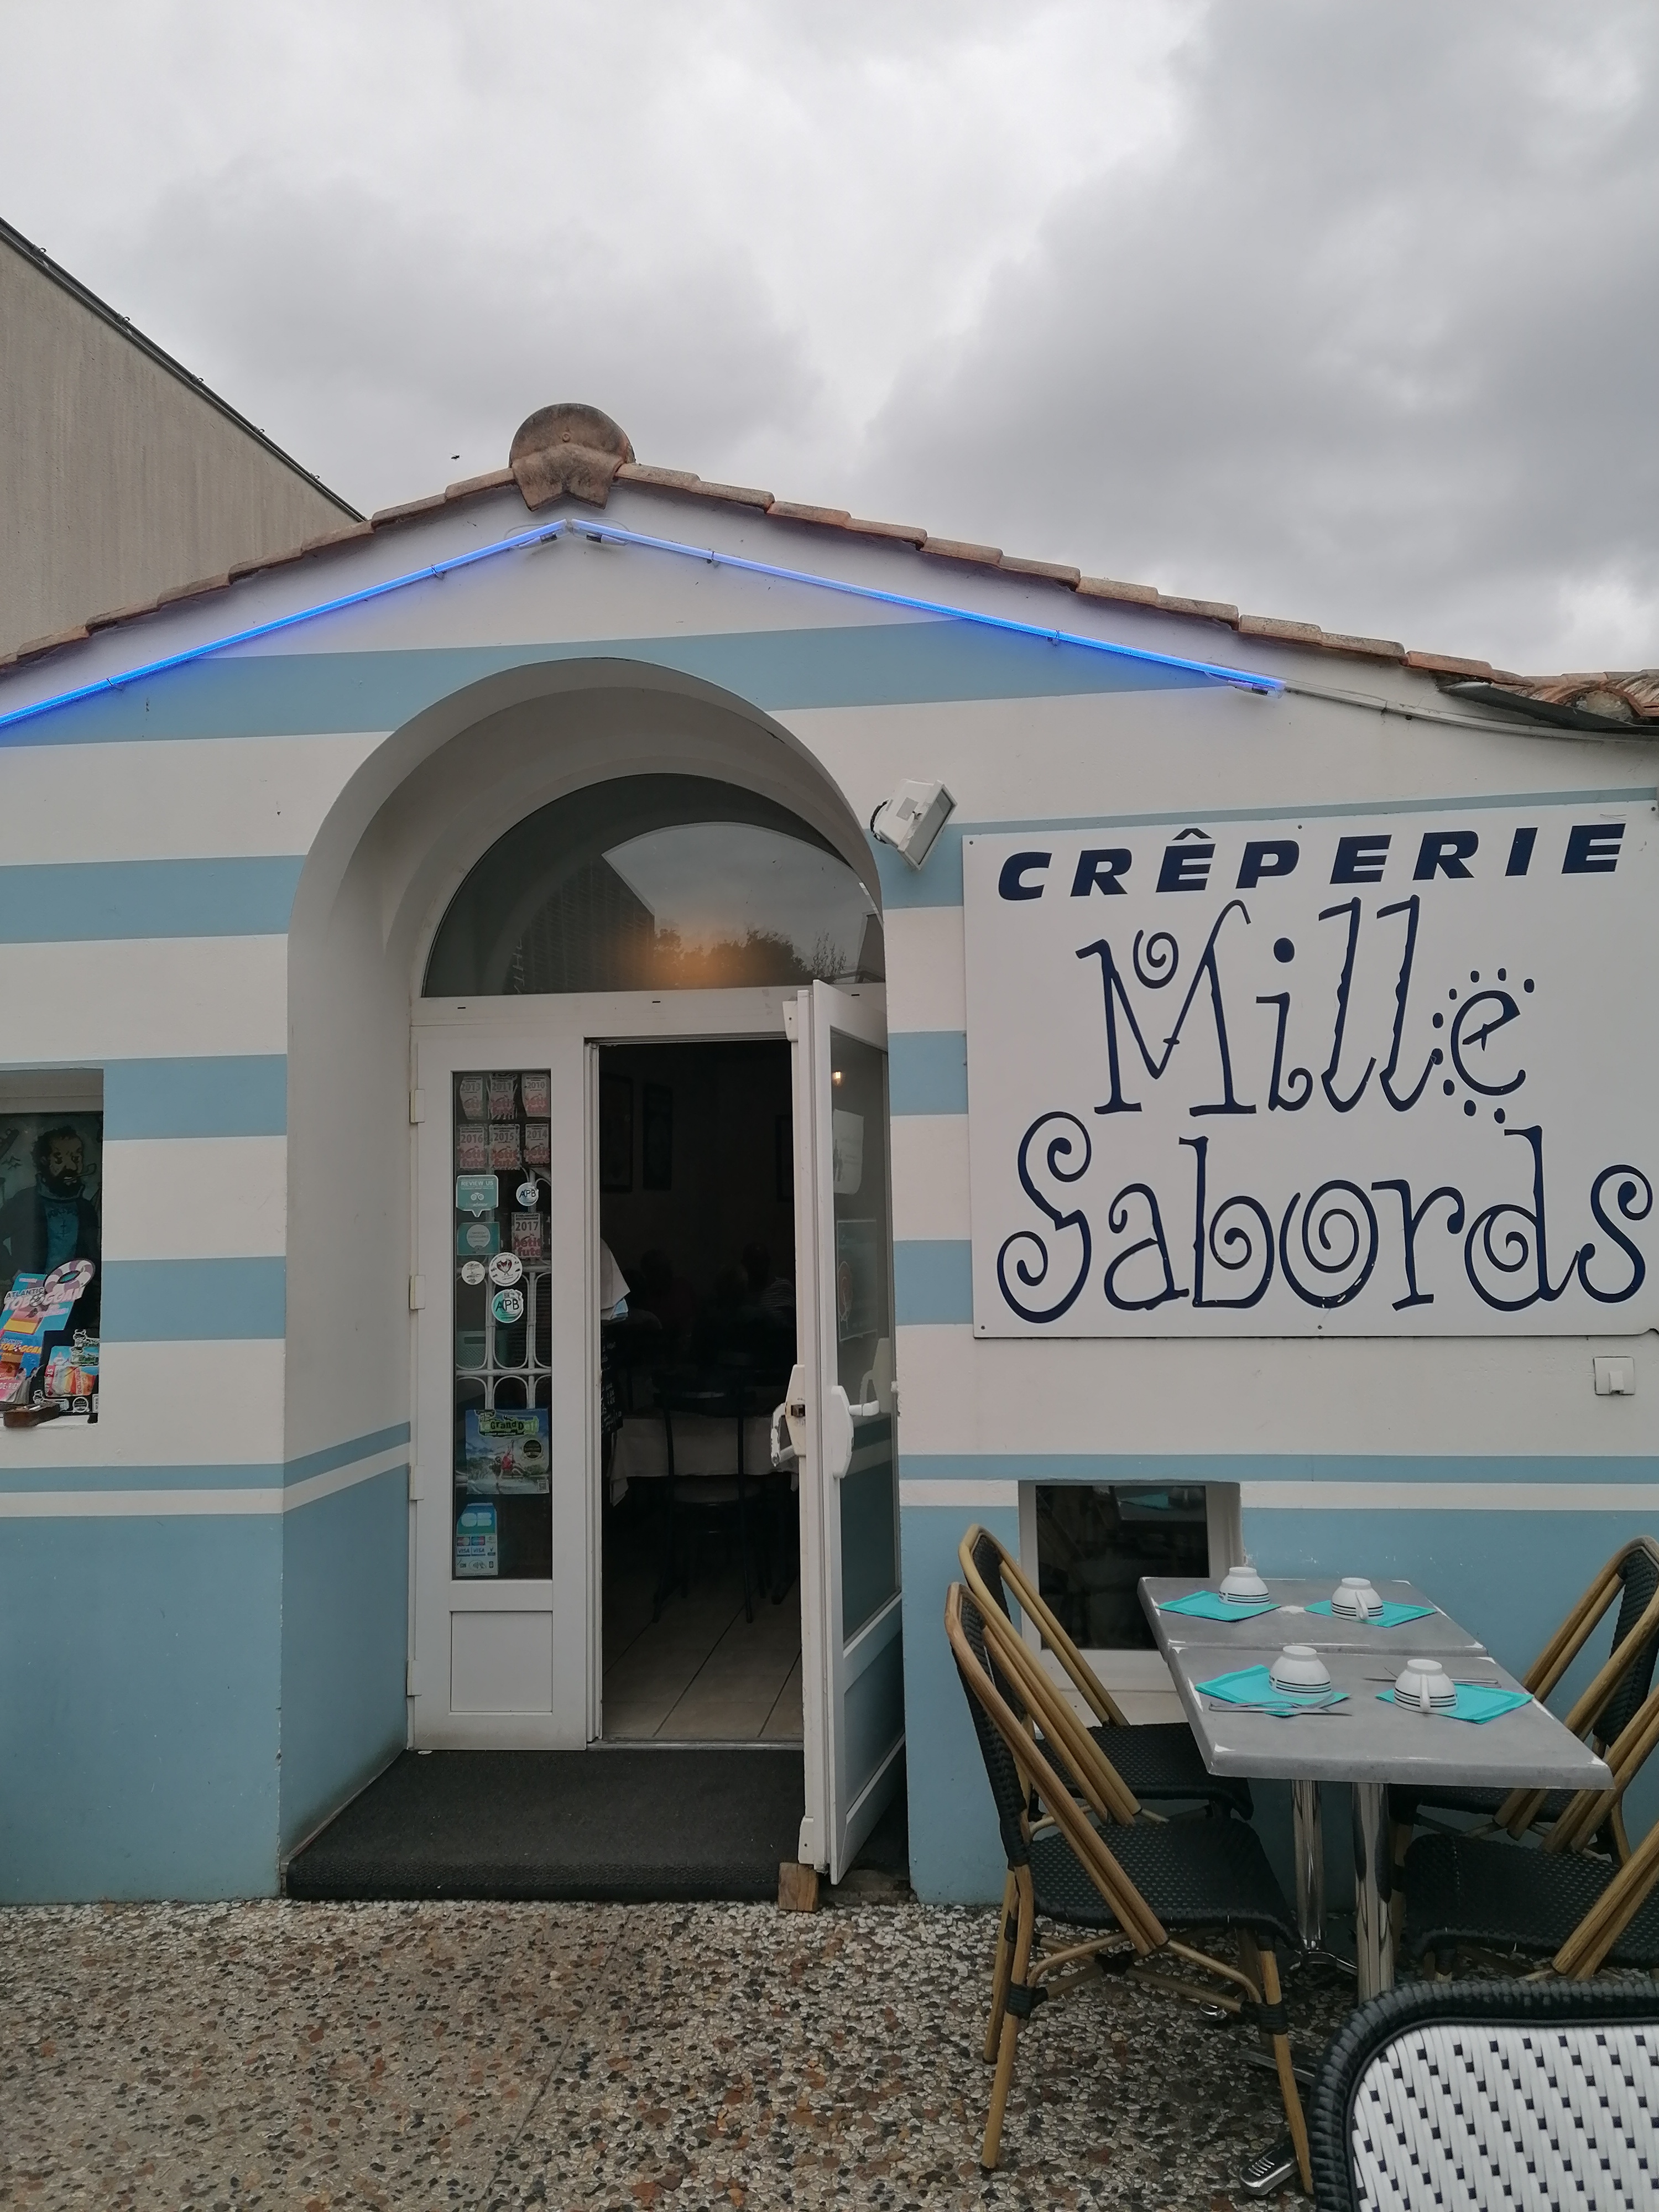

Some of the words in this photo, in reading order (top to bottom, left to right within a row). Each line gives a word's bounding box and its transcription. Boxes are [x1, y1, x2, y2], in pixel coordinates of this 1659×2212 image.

[998, 822, 1626, 901] CRÊPERIE
[526, 1081, 545, 1089] 2010
[461, 1134, 483, 1144] 2016
[494, 1132, 514, 1141] 2015
[526, 1130, 547, 1139] 2014
[997, 1111, 1653, 1323] Sabords
[515, 1222, 539, 1231] 2017
[6, 1287, 44, 1299] ATLANTIC
[490, 1420, 517, 1430] Grand
